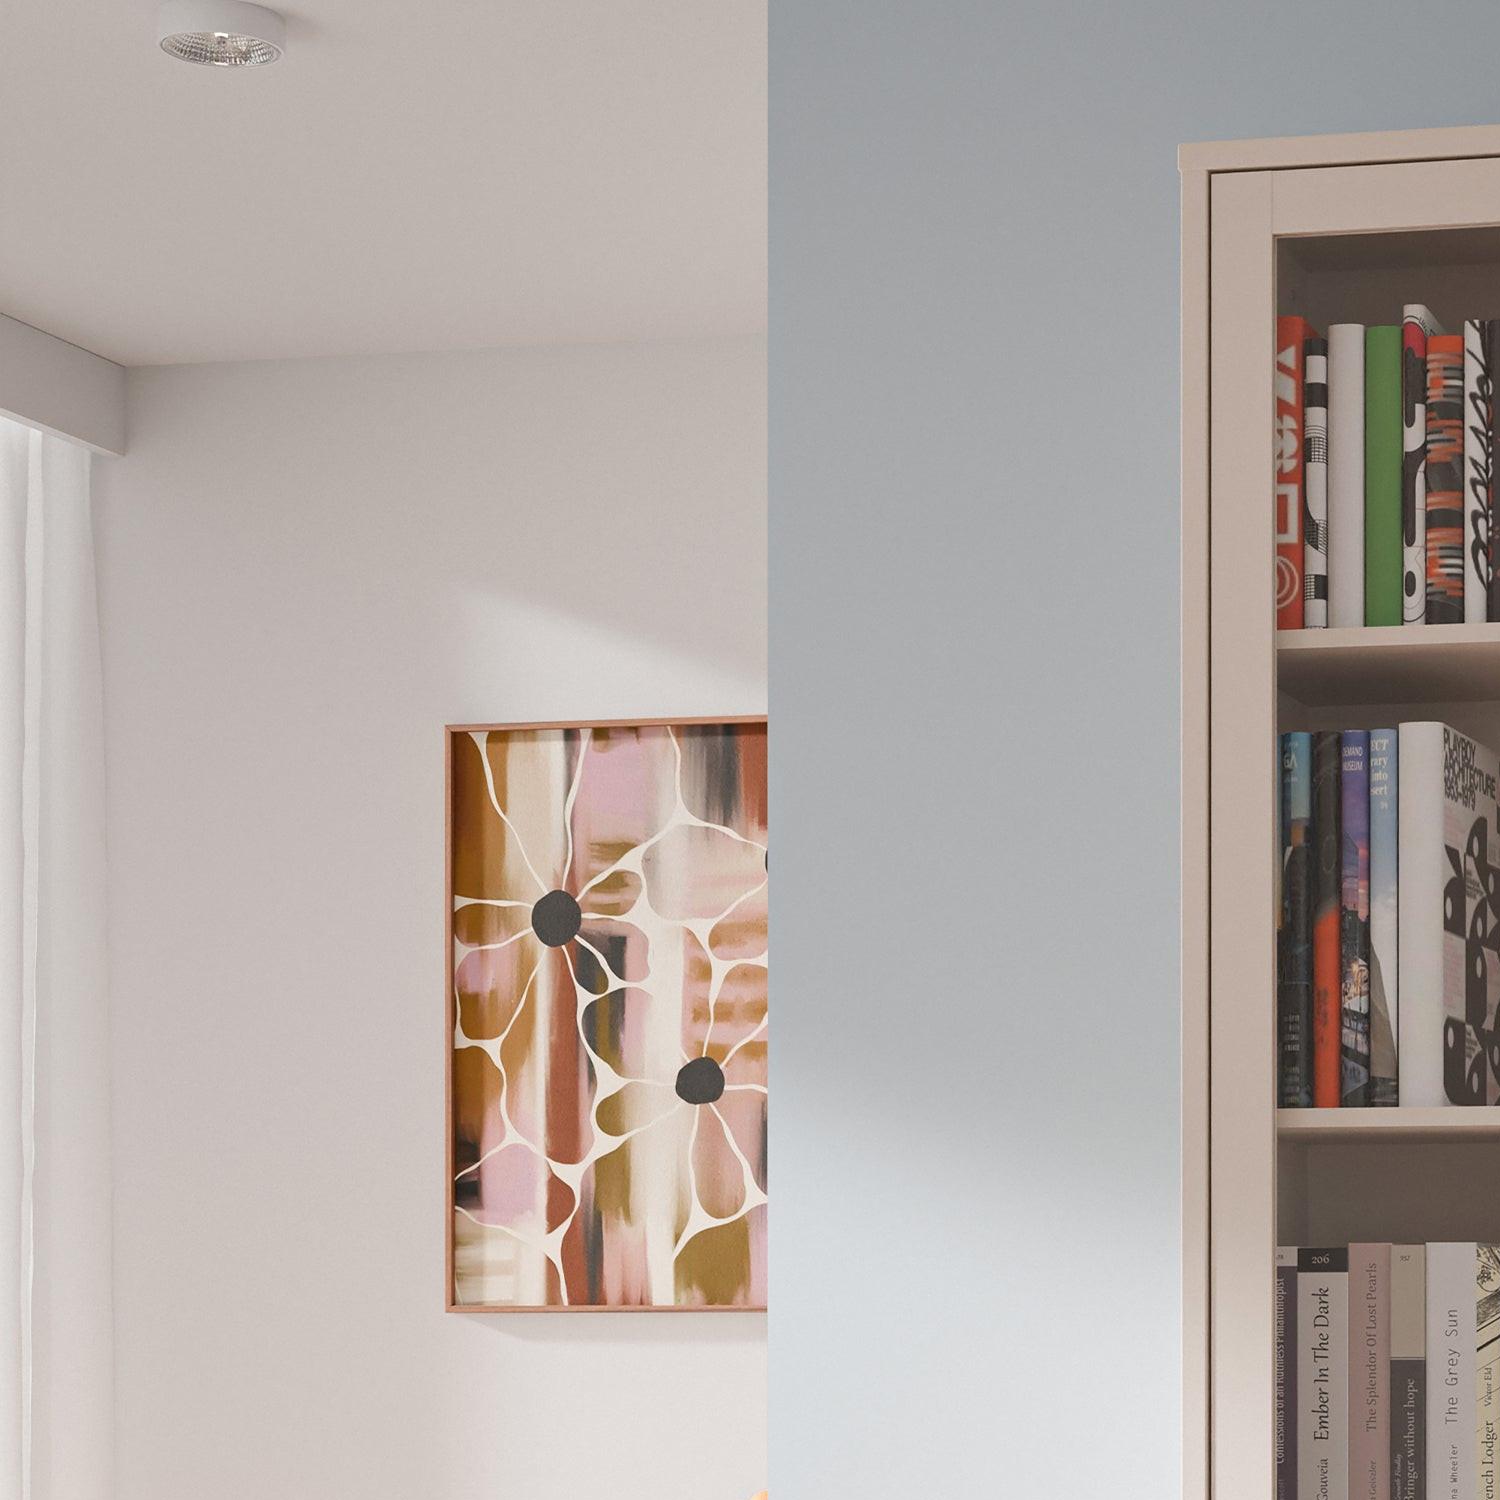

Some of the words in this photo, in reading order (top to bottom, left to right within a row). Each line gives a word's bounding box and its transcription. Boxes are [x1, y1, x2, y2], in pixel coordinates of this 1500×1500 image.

[1311, 1253, 1330, 1264] 206
[1366, 1263, 1376, 1300] Pearls
[1312, 1288, 1329, 1328] Dark
[1366, 1304, 1376, 1329] Lost
[1445, 1310, 1458, 1336] Sun
[1312, 1333, 1329, 1363] The
[1366, 1332, 1376, 1347] Of
[1314, 1367, 1328, 1383] In
[1366, 1350, 1379, 1405] Splendor
[1445, 1349, 1460, 1386] Grey
[1403, 1379, 1418, 1407] hope
[1312, 1388, 1329, 1440] Ember
[1366, 1409, 1376, 1432] The
[1445, 1397, 1458, 1424] The
[1403, 1412, 1415, 1457] without
[1481, 1421, 1497, 1464] Lodger
